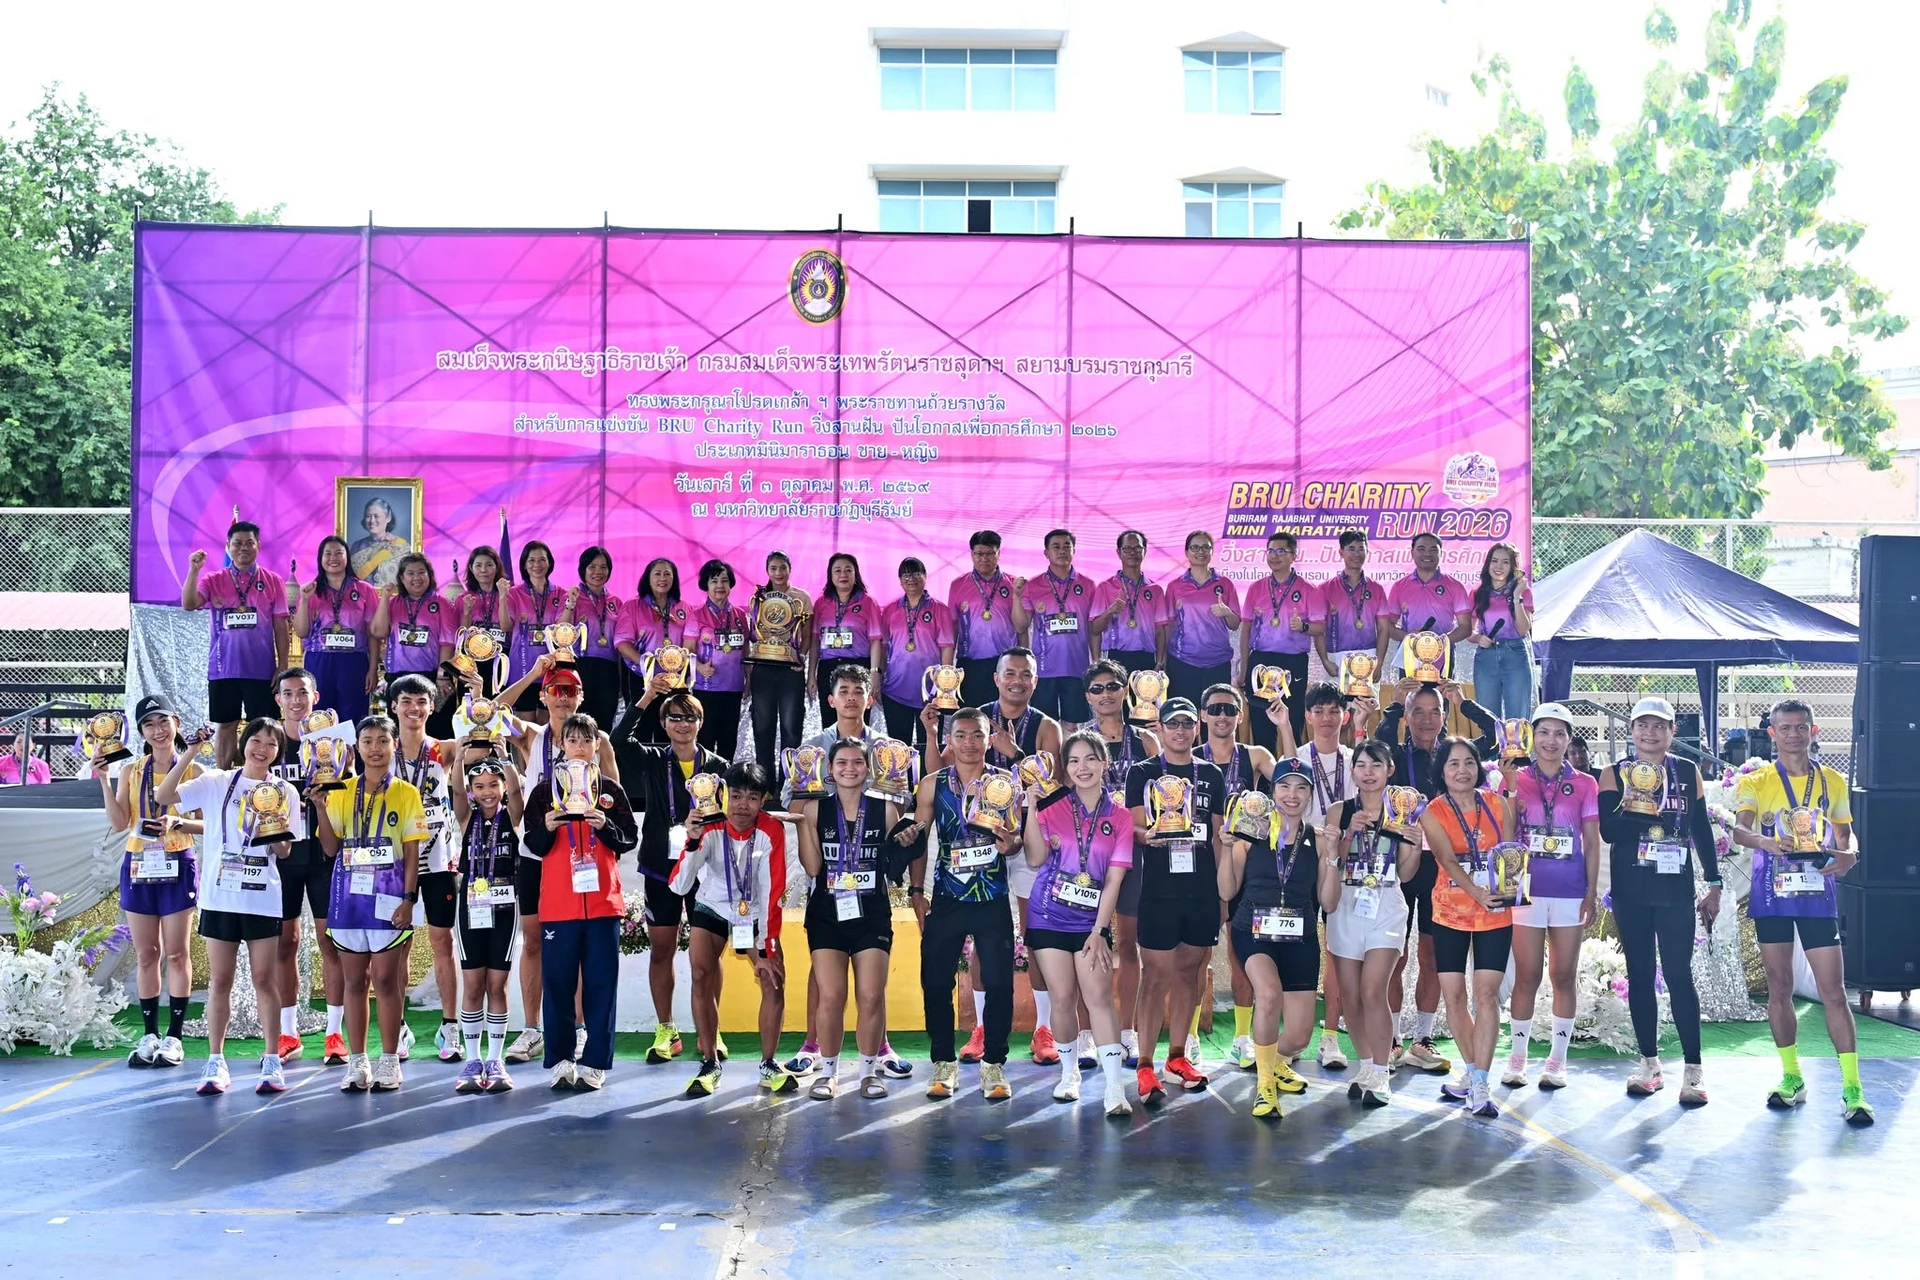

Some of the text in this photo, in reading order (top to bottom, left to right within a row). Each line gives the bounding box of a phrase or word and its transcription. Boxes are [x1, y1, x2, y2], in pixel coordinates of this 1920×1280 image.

[437, 345, 1194, 382] สมเด็จพระกนิษฐาธิราชเจ้า กรมสมเด็จพระเทพรัตนราชสุดาฯ สยามบรมราชกุมารี
[628, 389, 809, 413] ทรงพระกรุณาโปรดเกล้า
[836, 392, 1006, 411] พระราชทานถ้วยรางวัล
[515, 413, 1117, 438] สำหรับการแข่งขัน BRU Charity Run วิ่งสานฝัน ปันโอกาสเพื่อการศึกษา ๒๐๒๖
[696, 442, 849, 459] ประเภทมินิมาราธอน
[857, 445, 888, 459] ชาย
[901, 444, 938, 462] หญิง
[676, 472, 732, 493] วันเสาร์
[740, 471, 752, 492] ที่
[781, 477, 834, 498] ตุลาคม
[843, 477, 874, 493] พ.ศ.
[1228, 482, 1432, 509] BRU CHARITY
[692, 498, 912, 523] ณ มหาวิทยาลัยราชภัฏบุรีรัมย์
[1228, 514, 1369, 524] BURIRAM RAJABHAT UNIVERSITY
[1227, 525, 1266, 535] MINI
[1376, 511, 1509, 538] RUN 2026
[865, 829, 880, 838] PT
[973, 848, 991, 857] 1348
[1074, 887, 1098, 899] V1016
[1279, 920, 1295, 928] 776
